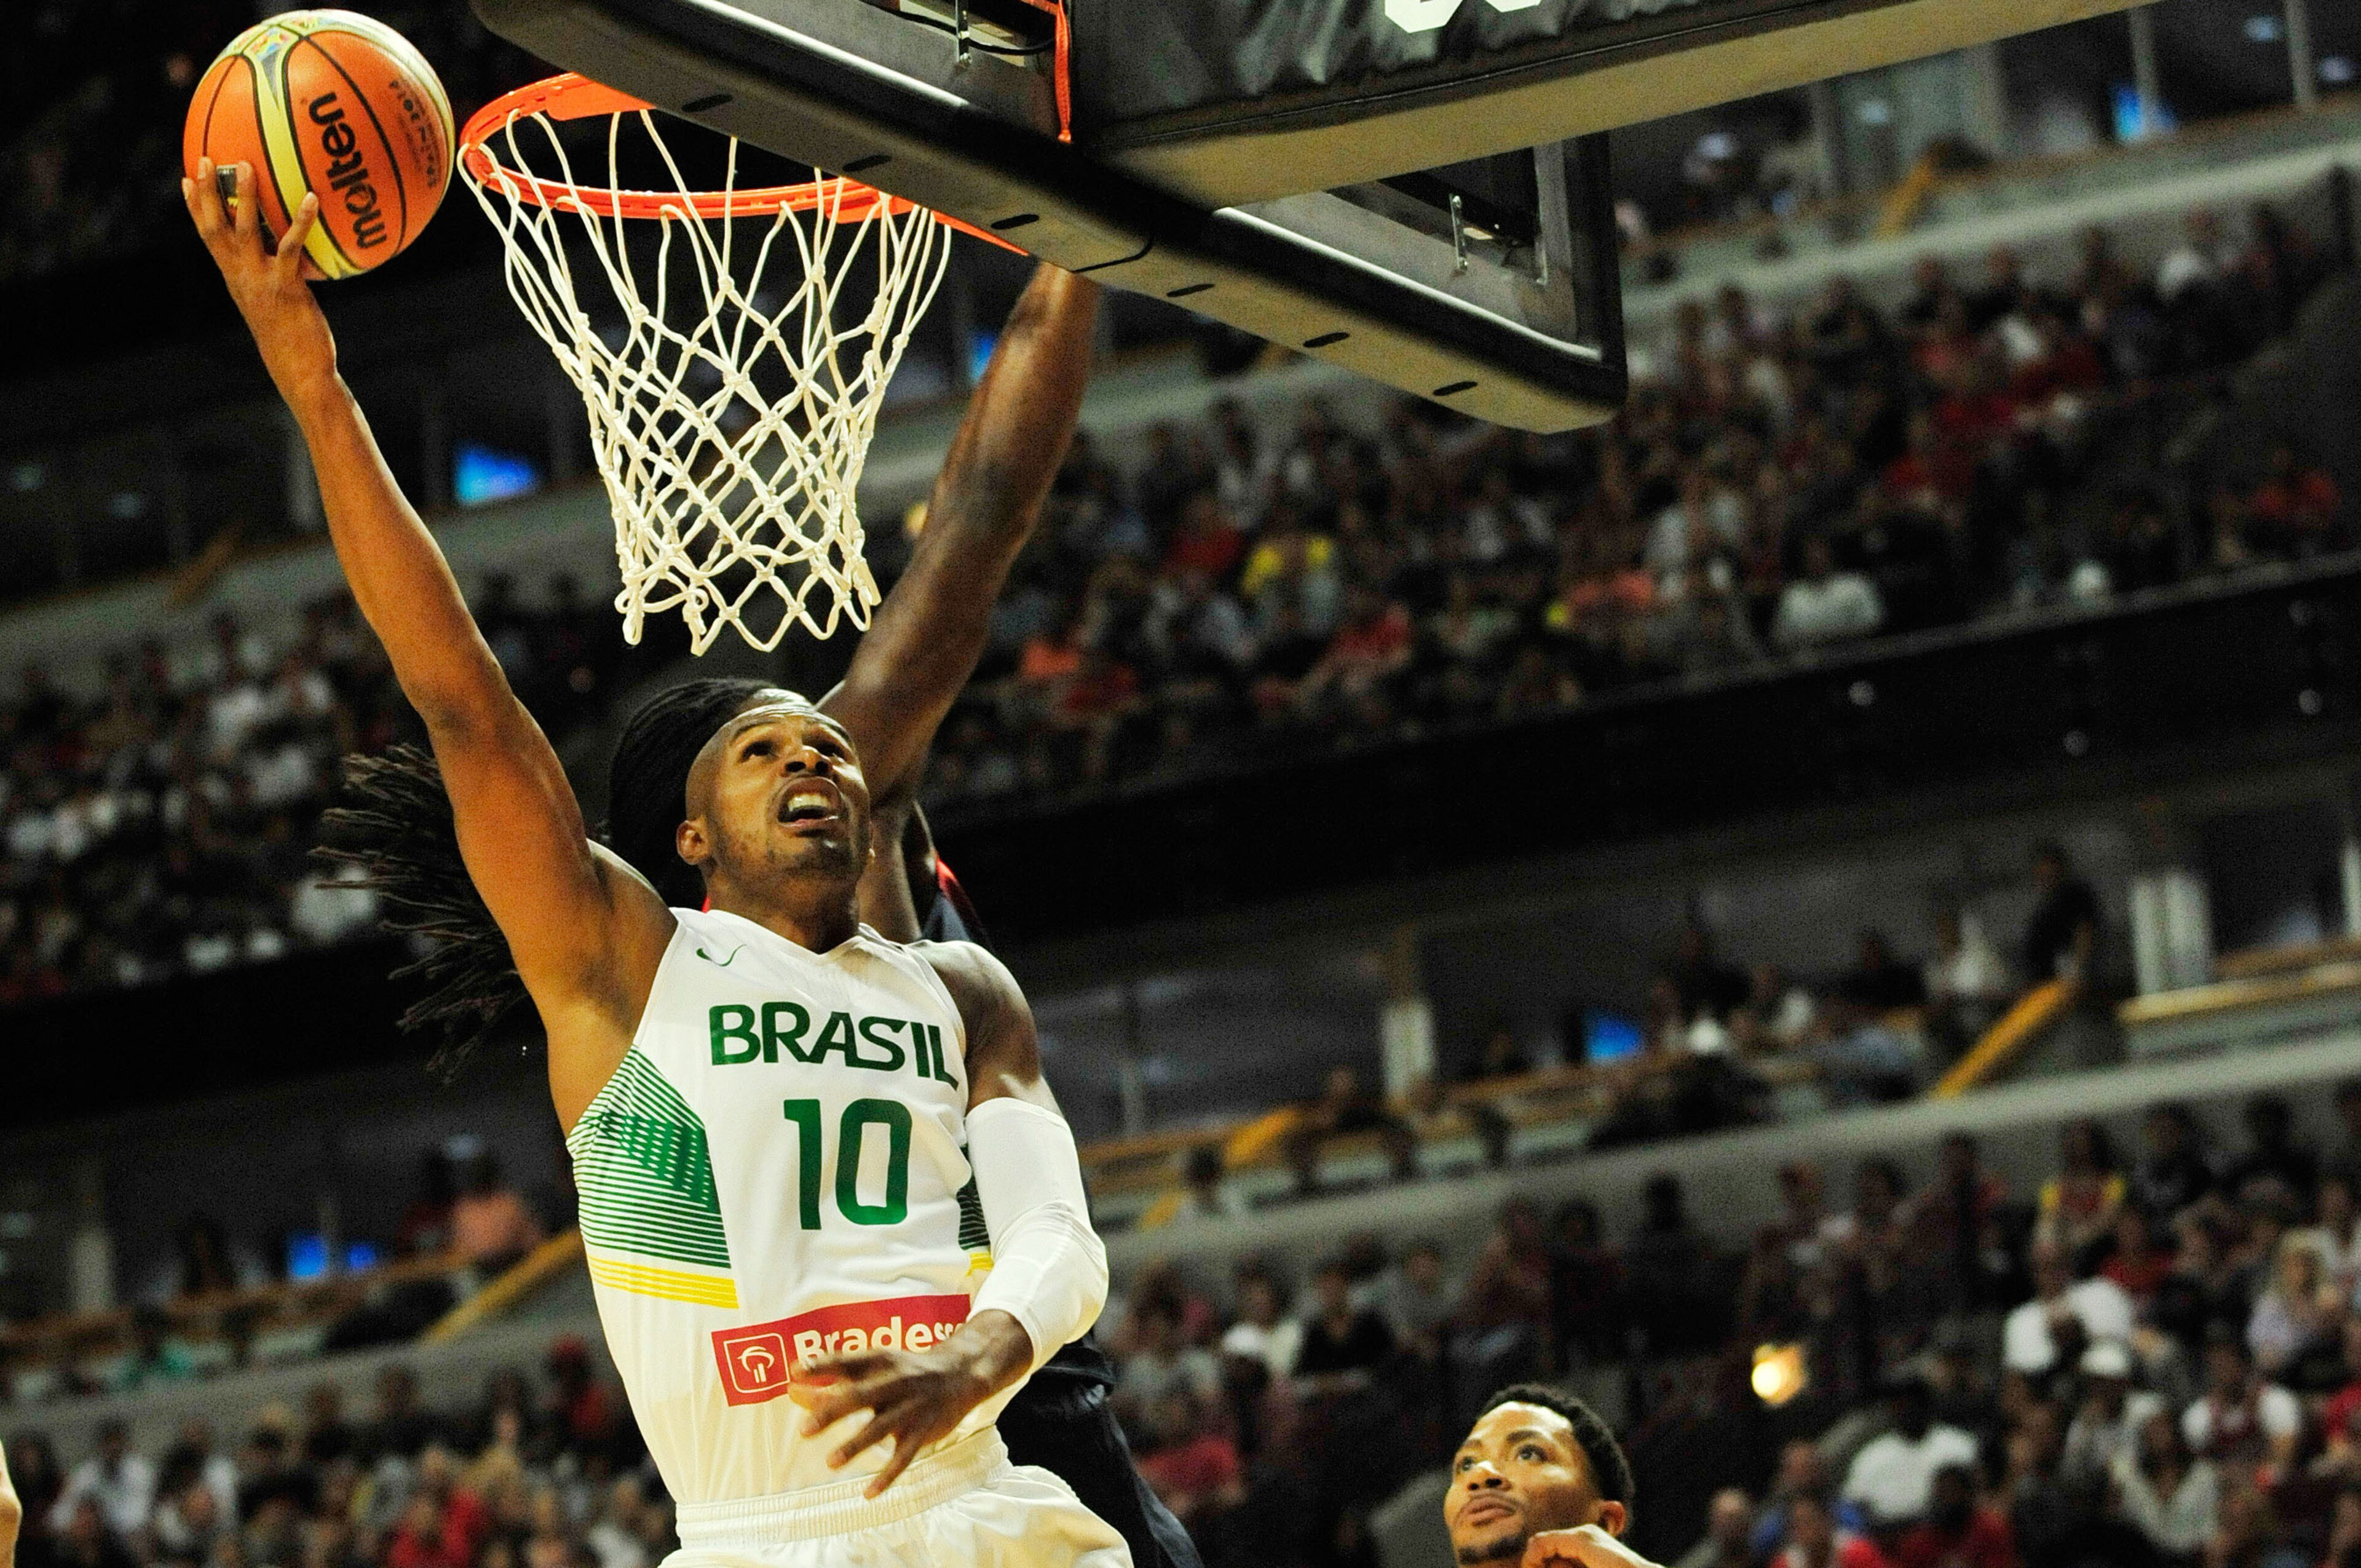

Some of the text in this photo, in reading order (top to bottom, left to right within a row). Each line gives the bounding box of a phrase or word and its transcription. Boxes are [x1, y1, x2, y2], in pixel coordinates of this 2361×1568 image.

[309, 92, 387, 248] molten
[709, 1002, 959, 1089] BRASIL
[783, 1098, 912, 1230] 10
